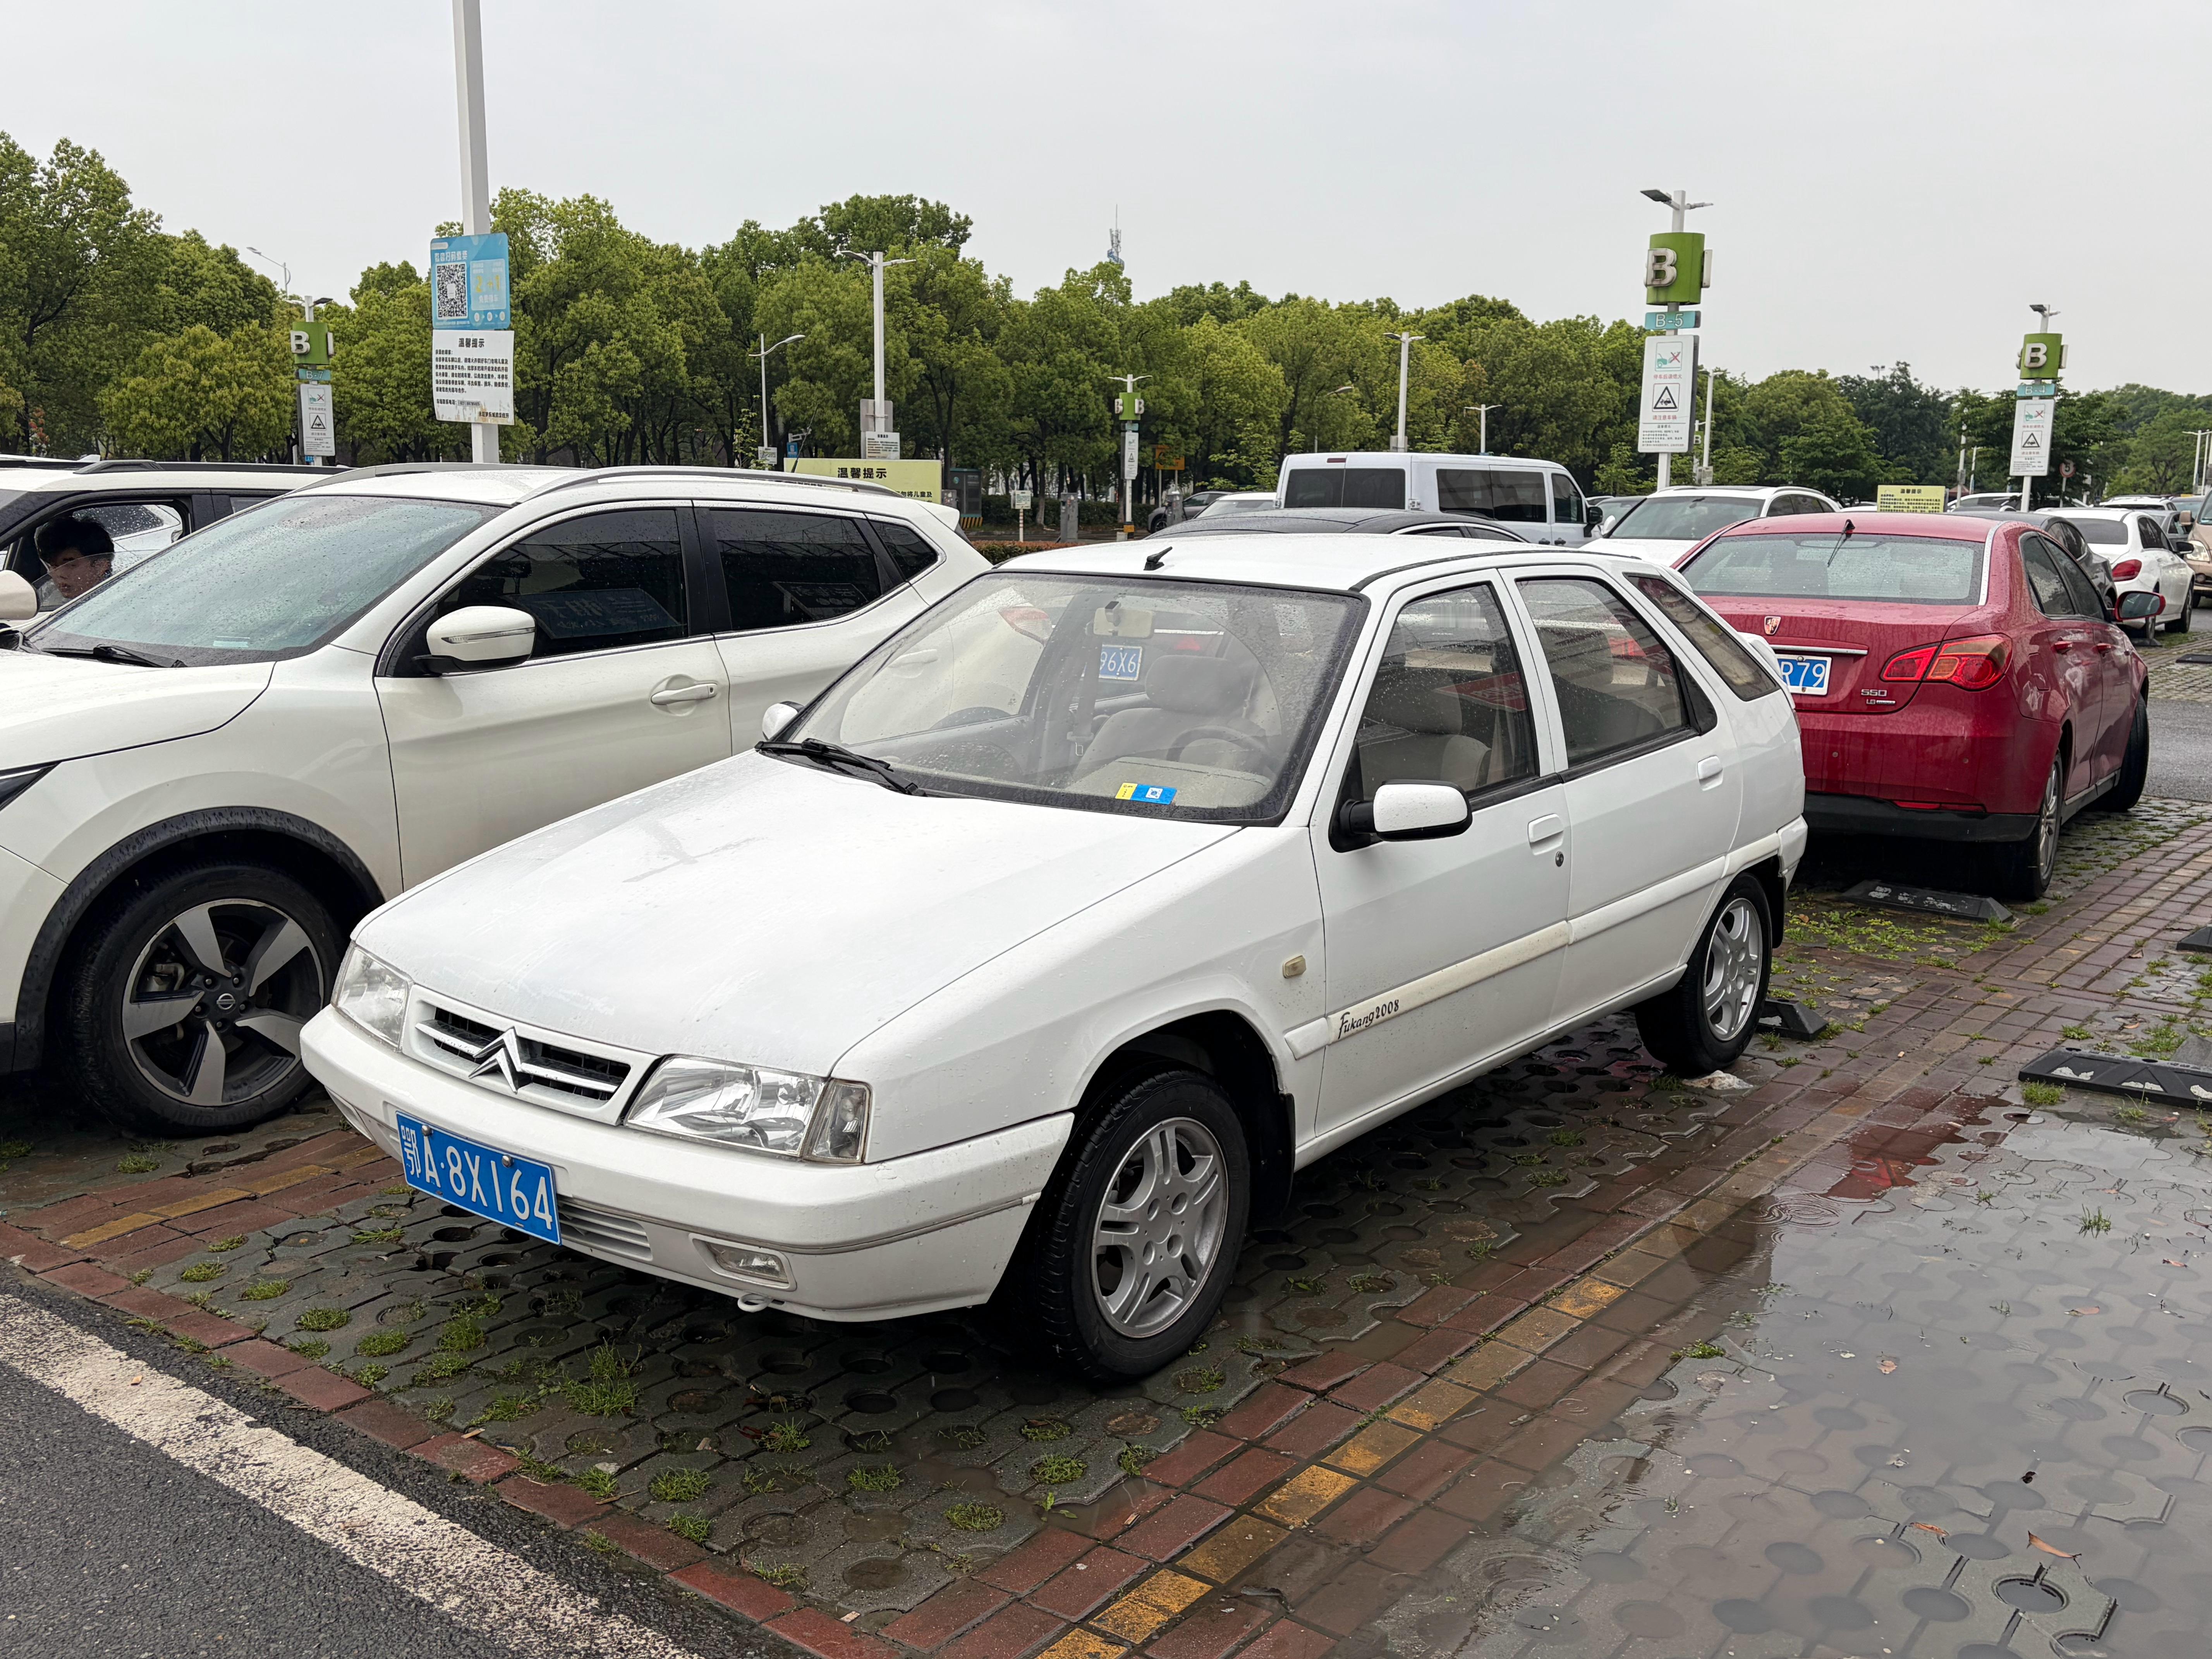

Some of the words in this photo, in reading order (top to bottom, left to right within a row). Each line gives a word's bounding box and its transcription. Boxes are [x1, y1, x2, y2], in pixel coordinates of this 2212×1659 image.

[1647, 248, 1677, 287] B
[1656, 313, 1683, 327] B-5
[290, 330, 310, 354] B
[459, 338, 484, 348] 温馨提示
[2025, 343, 2047, 368] B
[306, 370, 323, 379] B-7
[1693, 434, 1702, 445] B
[837, 467, 887, 479] 温馨提示
